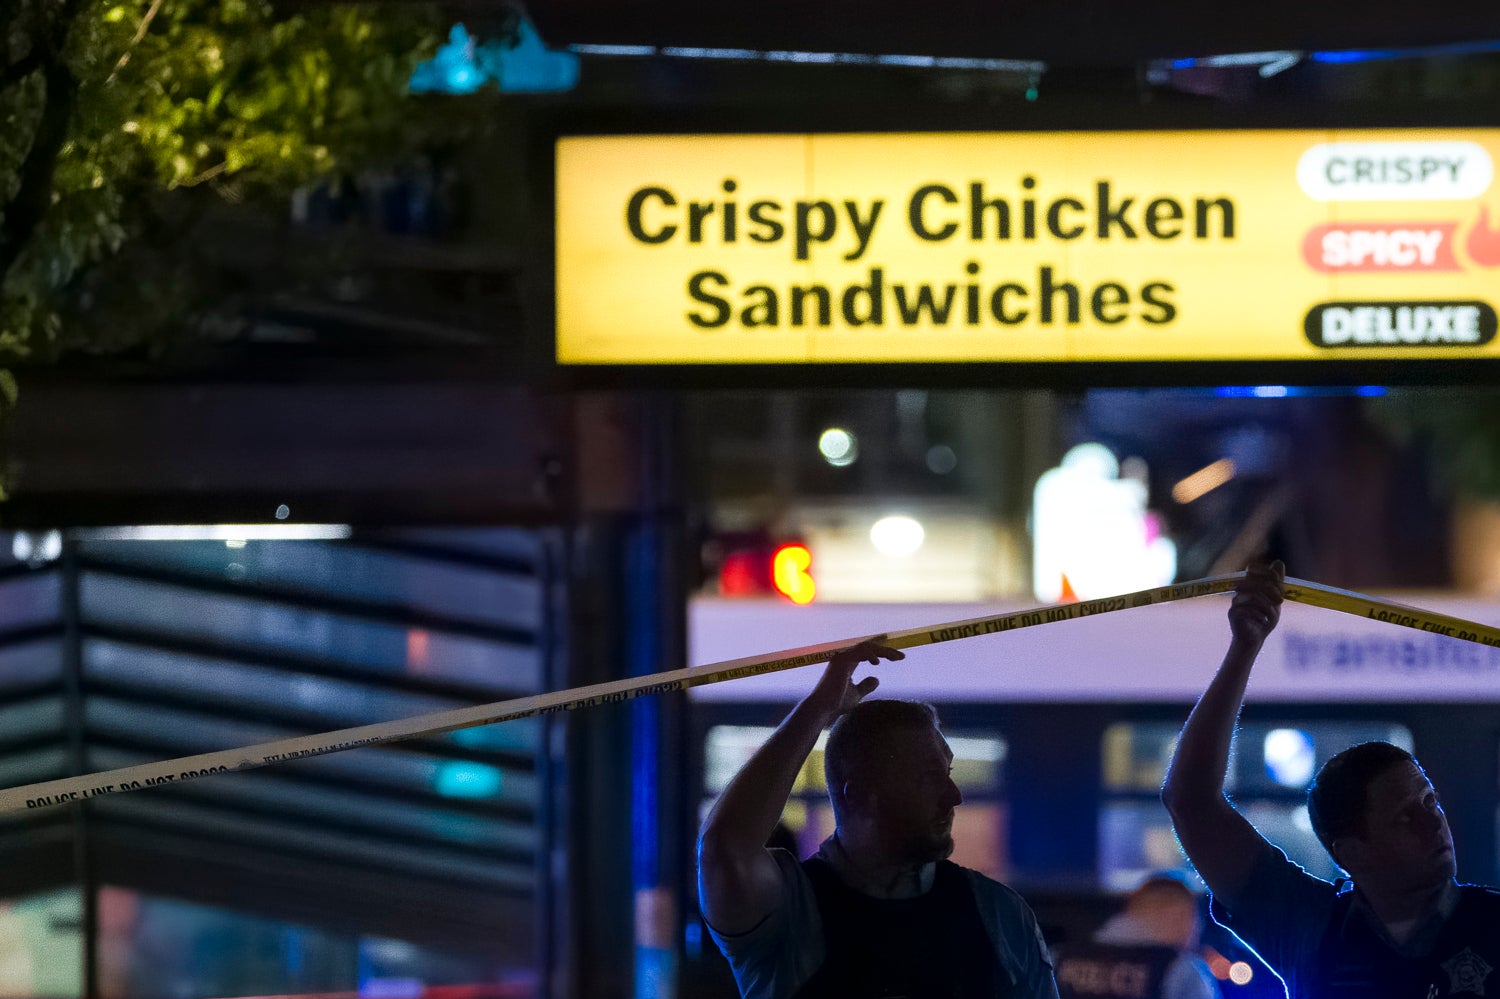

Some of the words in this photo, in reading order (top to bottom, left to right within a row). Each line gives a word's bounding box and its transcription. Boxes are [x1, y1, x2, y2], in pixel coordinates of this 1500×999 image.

[1324, 156, 1465, 186] CRISPY
[625, 179, 884, 262] Crispy
[907, 177, 1237, 243] Chicken
[1321, 230, 1443, 267] SPICY
[686, 262, 1178, 329] Sandwiches
[1321, 306, 1481, 344] DELUXE
